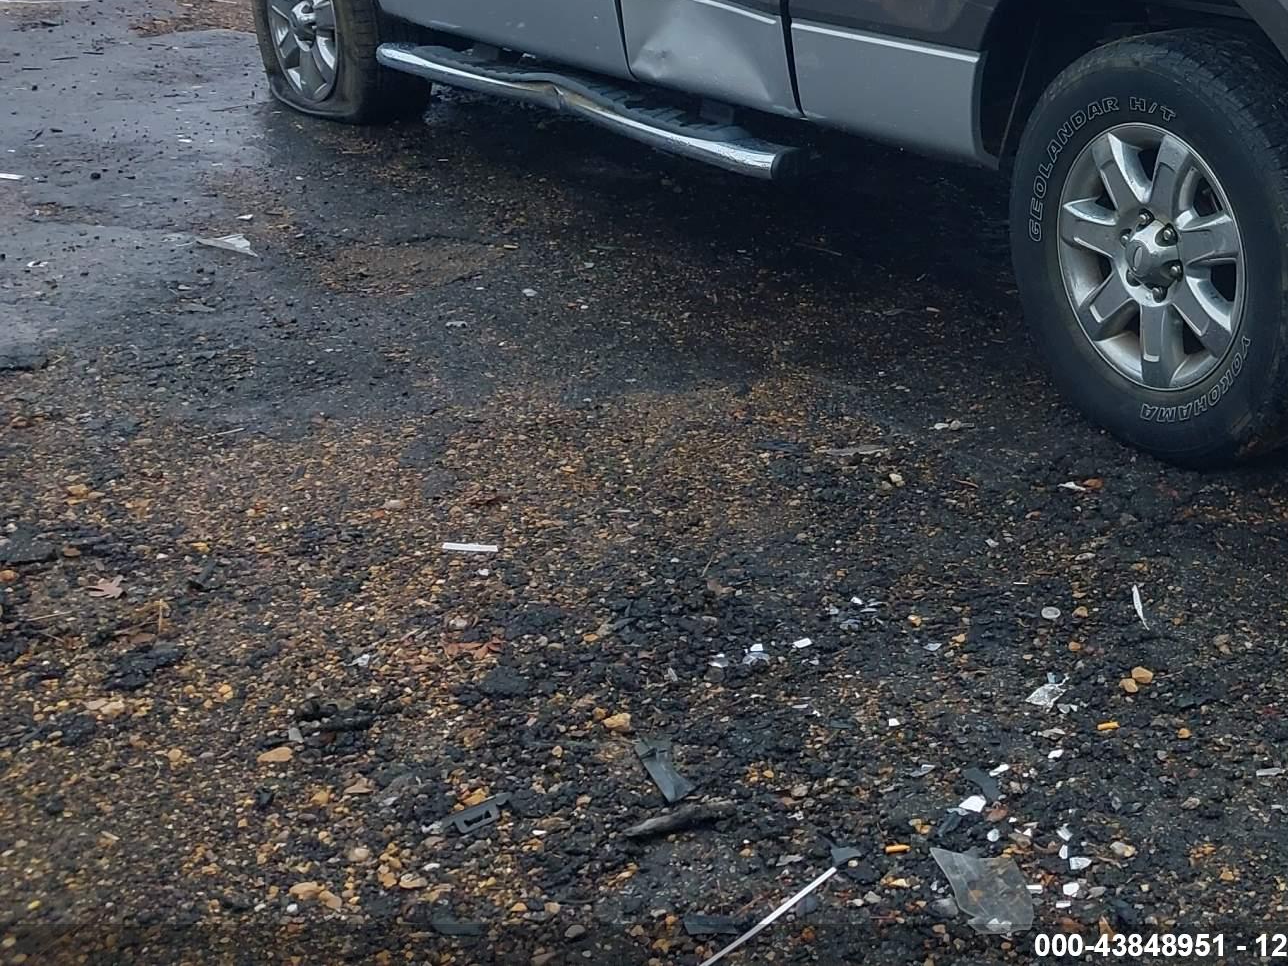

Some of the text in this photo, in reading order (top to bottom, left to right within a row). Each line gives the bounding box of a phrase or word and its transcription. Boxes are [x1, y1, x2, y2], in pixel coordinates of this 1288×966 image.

[1029, 96, 1177, 243] GEOLANDAR H/T
[1140, 335, 1251, 423] YOKOHAMA
